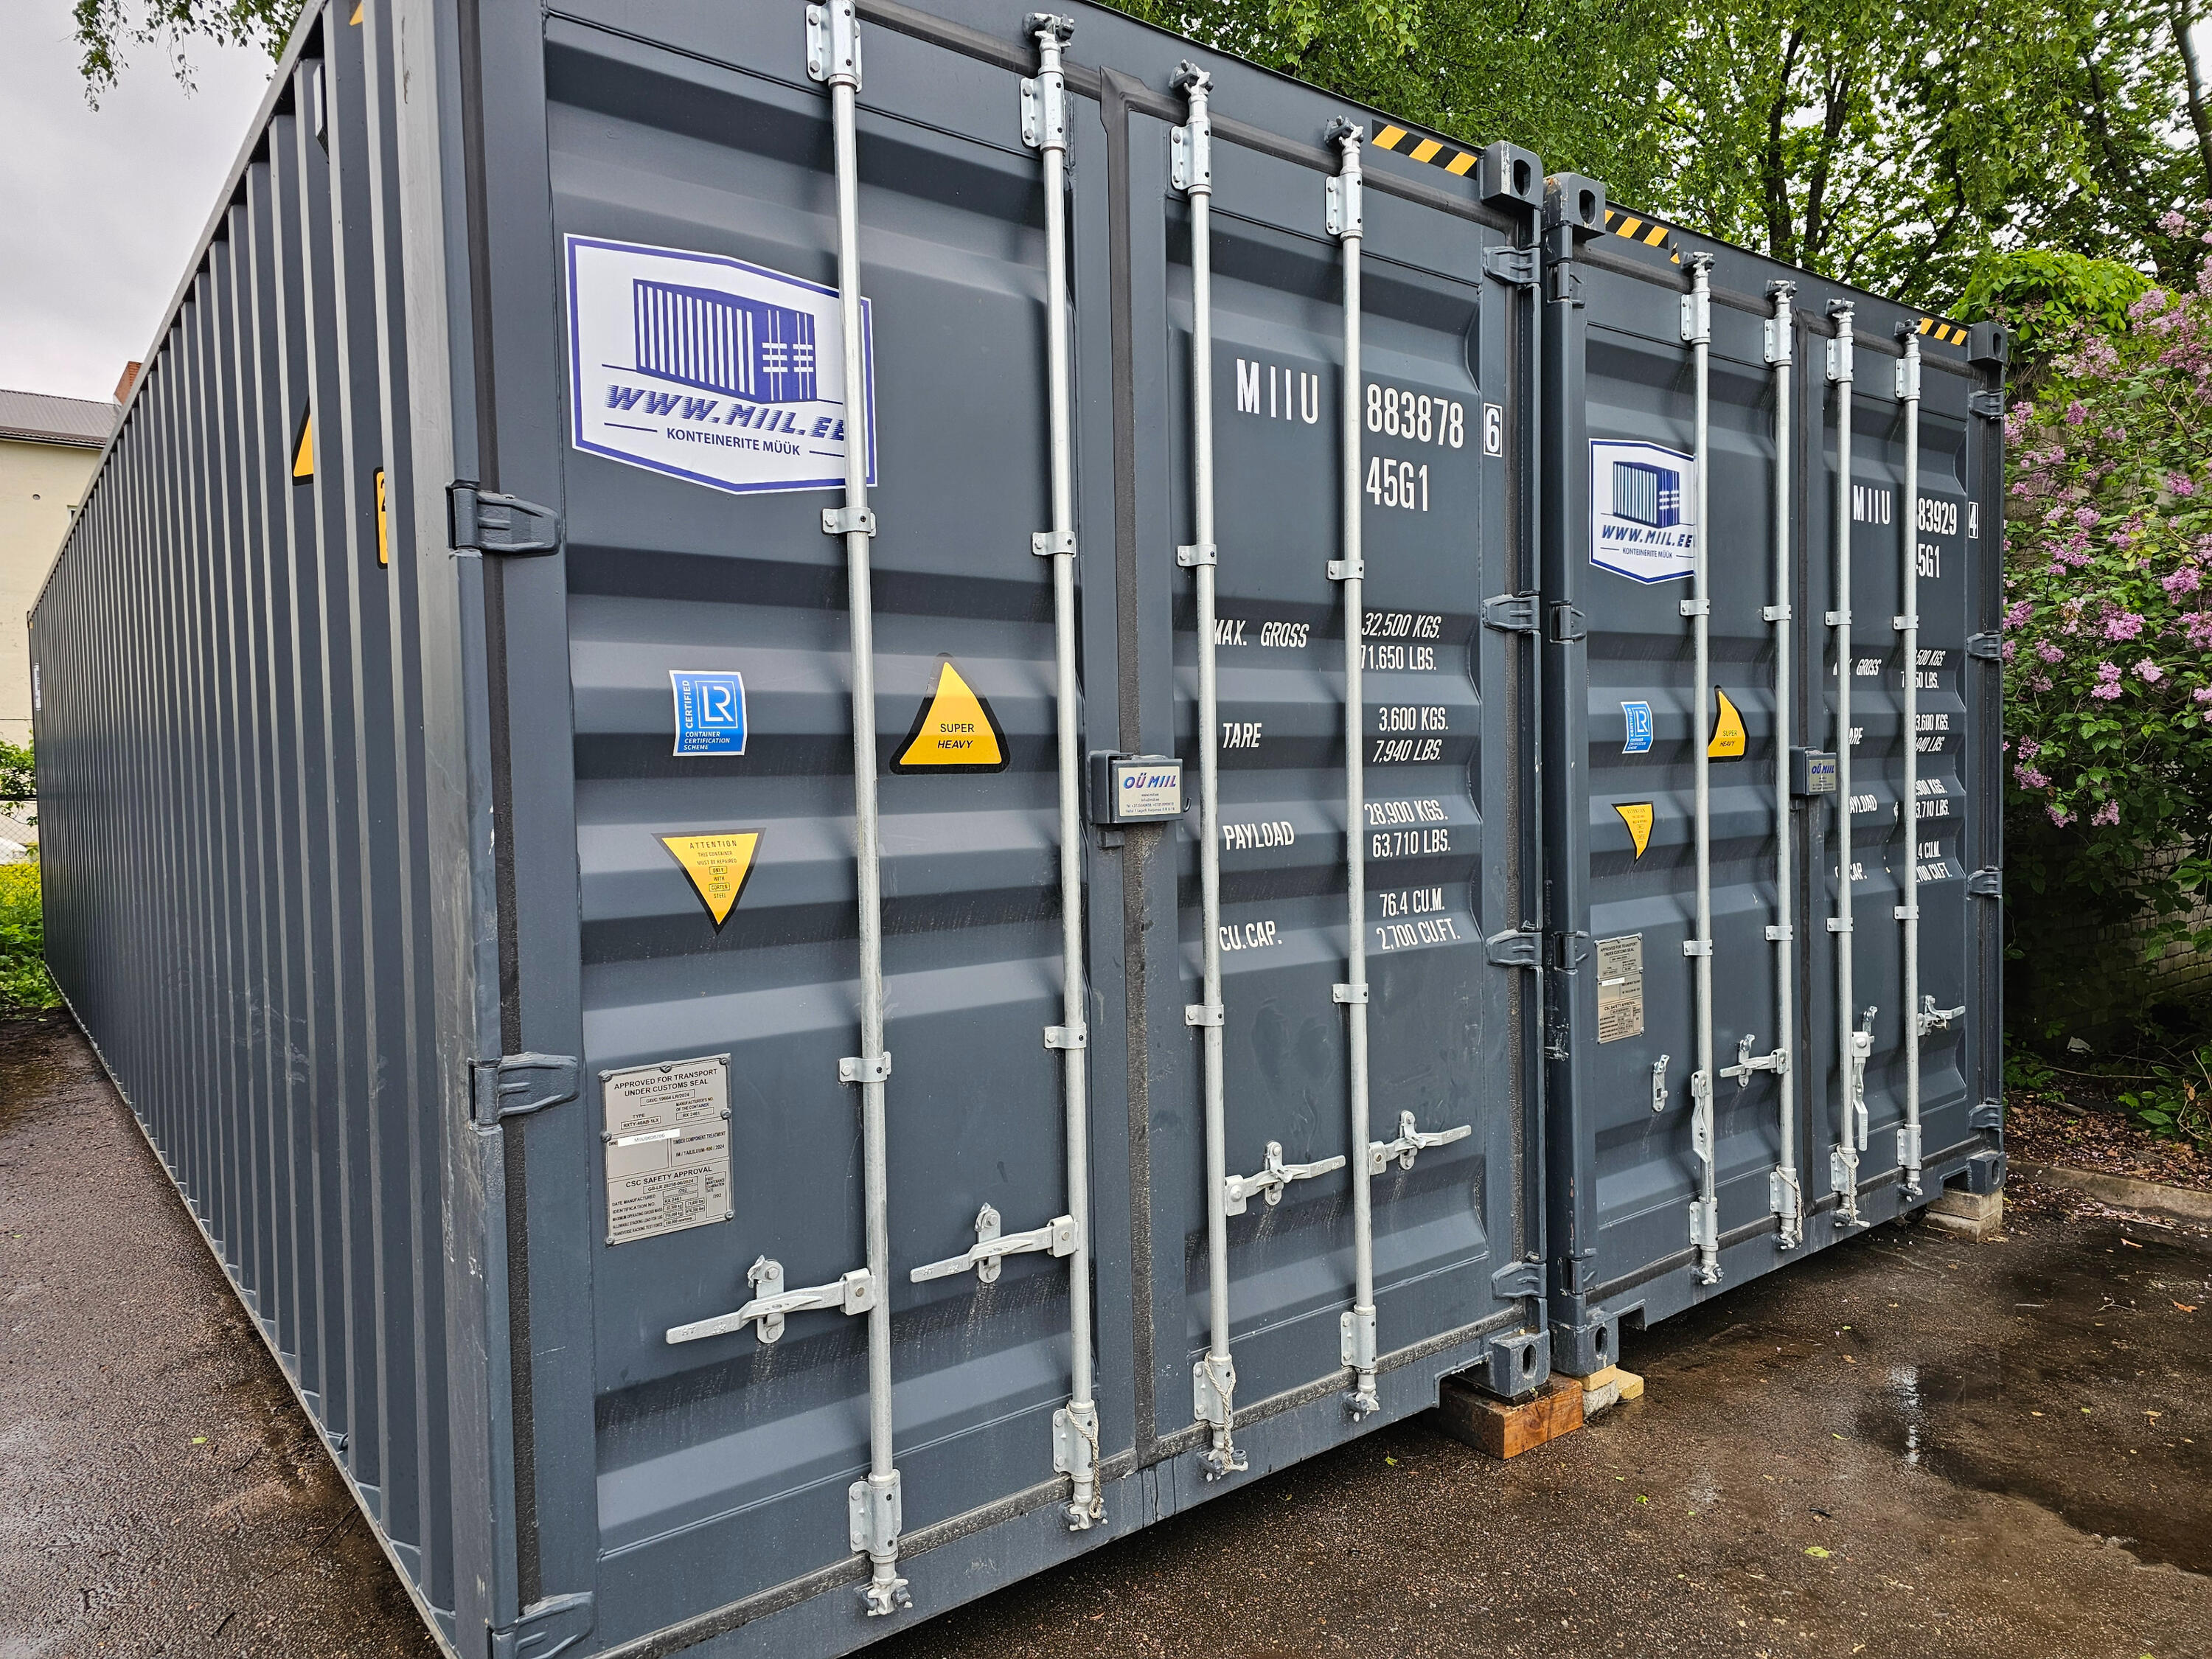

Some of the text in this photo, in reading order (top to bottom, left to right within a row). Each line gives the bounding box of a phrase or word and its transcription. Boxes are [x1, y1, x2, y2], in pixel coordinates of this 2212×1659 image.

[1237, 358, 1500, 453] MIIU 883878 6
[667, 428, 800, 455] KONTEINERITE MÜÜK
[1366, 456, 1427, 512] 45G1
[1853, 485, 1890, 525] MIIU
[1916, 498, 1976, 536] 83929 4
[1602, 525, 1692, 547] WWW.MIIL.EE
[1623, 547, 1657, 557] KONTEINERITE
[1916, 543, 1939, 578] 5G1
[1261, 622, 1310, 647] GROSS
[1362, 613, 1441, 639] 32,500 KGS.
[1361, 644, 1436, 670] 71,650 LBS.
[1857, 659, 1882, 675] GROSS
[1925, 672, 1938, 688] LBS.
[682, 681, 693, 728] CERTIFIED
[702, 686, 734, 721] LR
[940, 724, 974, 732] SUPER
[1379, 707, 1448, 732] 3,600 KGS.
[1635, 710, 1648, 732] LR
[1916, 714, 1949, 731] 3,600 KGS.
[938, 740, 973, 748] HEAVY
[1223, 723, 1262, 748] TARE
[1849, 728, 1863, 745] ARE
[1373, 740, 1442, 763] 7,940 LBS.
[1124, 773, 1176, 789] OÜ MIIL
[1927, 779, 1947, 794] KGS.
[1364, 799, 1448, 825] 28,900 KGS.
[1849, 795, 1877, 813] AYLOAD
[1916, 799, 1949, 818] 3,710 LBS.
[690, 841, 737, 849] ATTENTION
[1223, 821, 1294, 850] PAYLOAD
[1373, 829, 1451, 858] 63,710 LBS.
[1380, 888, 1445, 917] 76.4 CU.M.
[1377, 919, 1461, 950] 2,700 CU.FT.
[614, 1078, 655, 1089] APPROVED
[675, 1069, 717, 1080] TRANSPORT
[625, 1087, 650, 1096] UNDER
[653, 1082, 688, 1092] CUSTOMS
[644, 1174, 671, 1184] SAFETY
[674, 1166, 712, 1178] APPROVAL
[613, 1204, 644, 1214] IDENTIFICATION
[624, 1194, 655, 1204] MANUFACTURED
